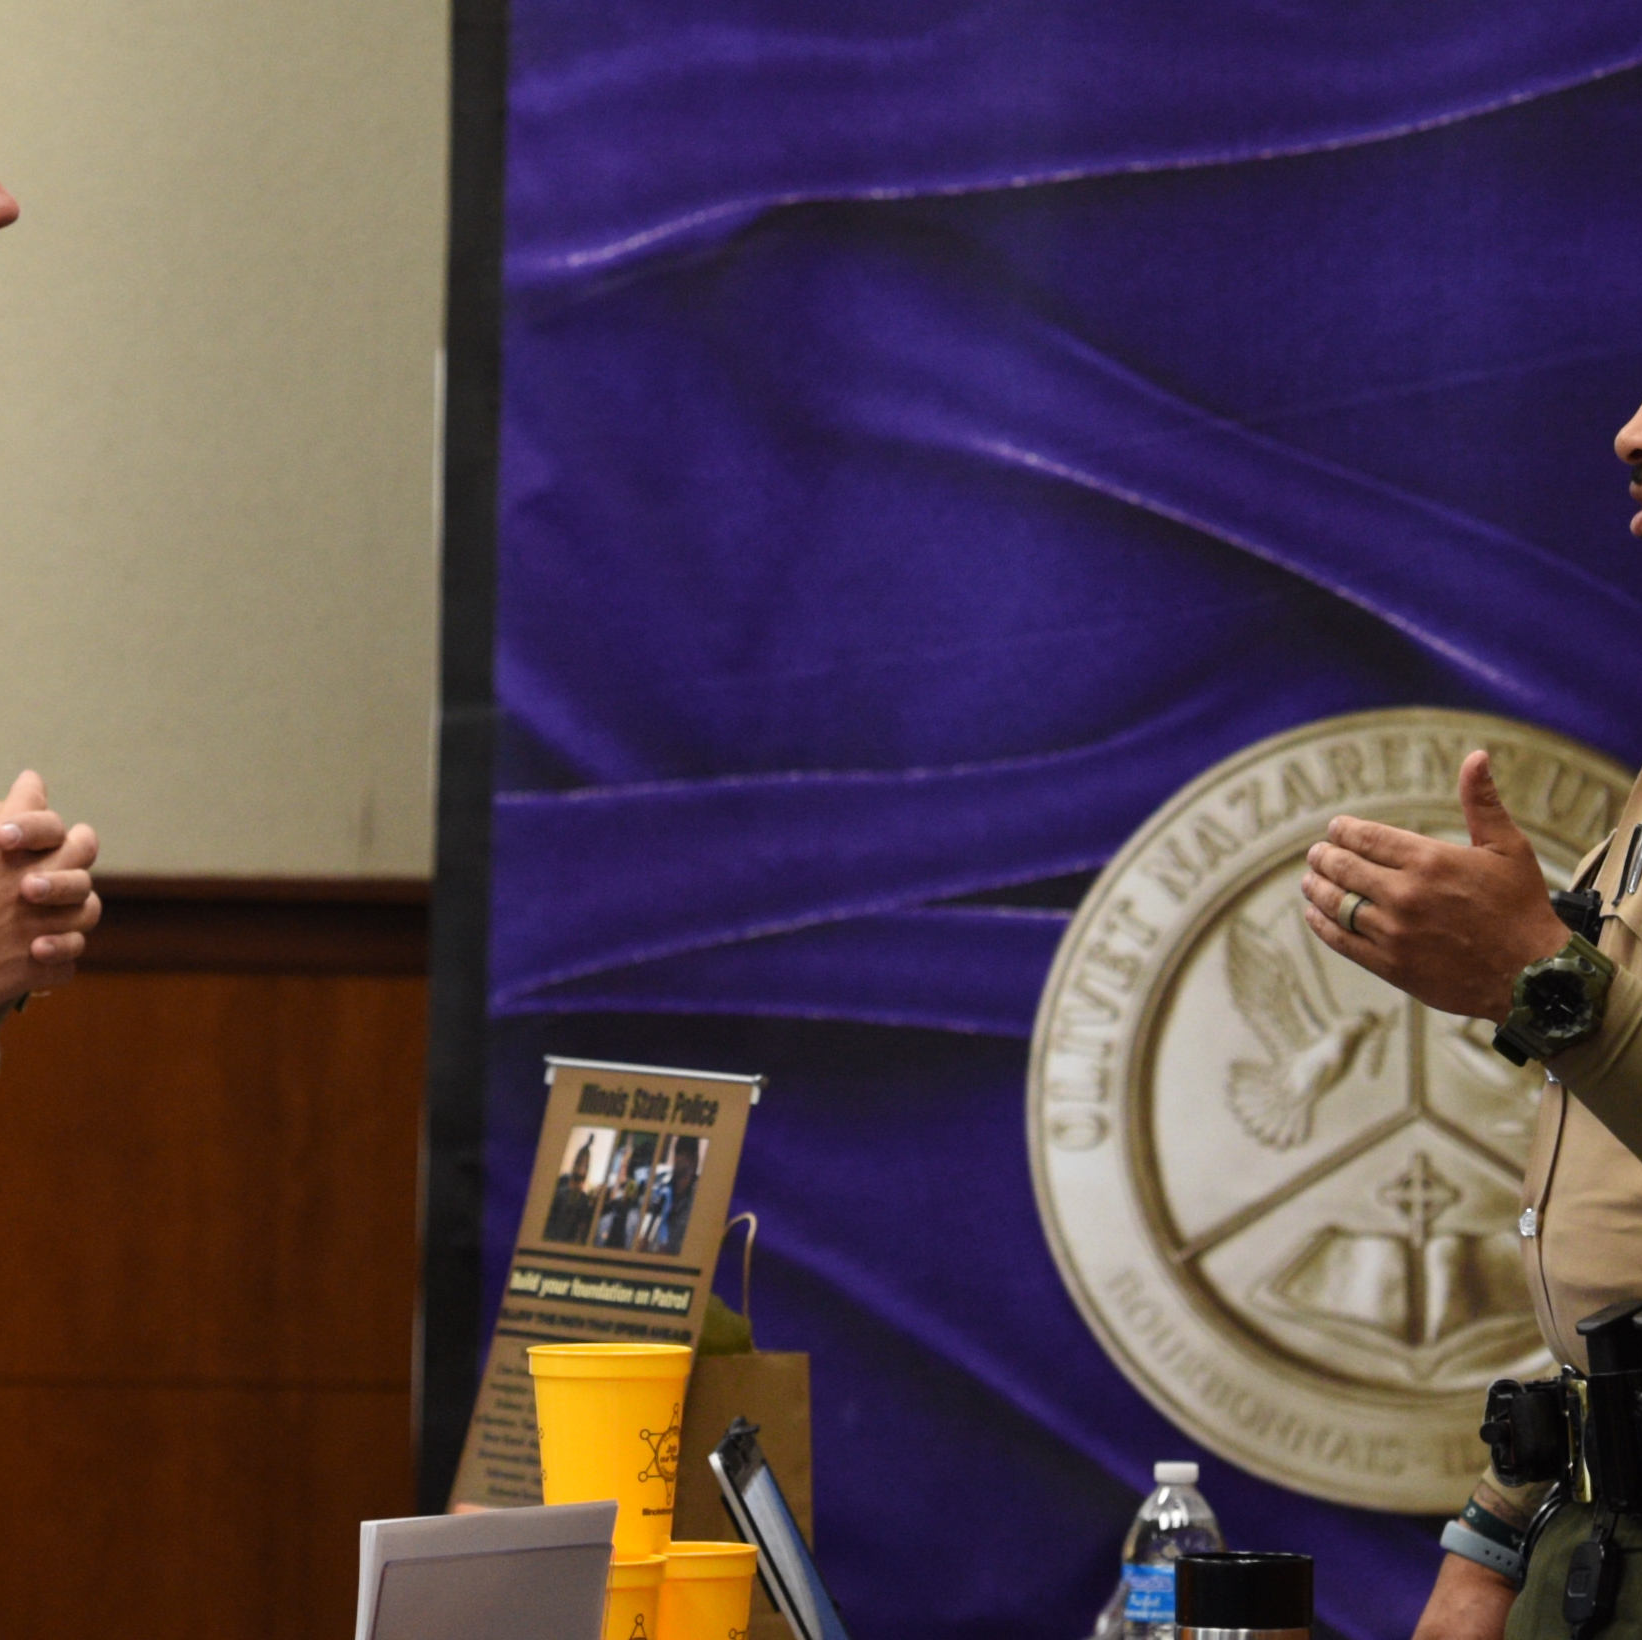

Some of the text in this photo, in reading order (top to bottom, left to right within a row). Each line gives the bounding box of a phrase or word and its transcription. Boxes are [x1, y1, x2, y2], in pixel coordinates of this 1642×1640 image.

[1044, 895, 1161, 1153] OLIVET
[577, 1082, 719, 1127] Illinois State Police
[650, 1285, 691, 1311] Patrol
